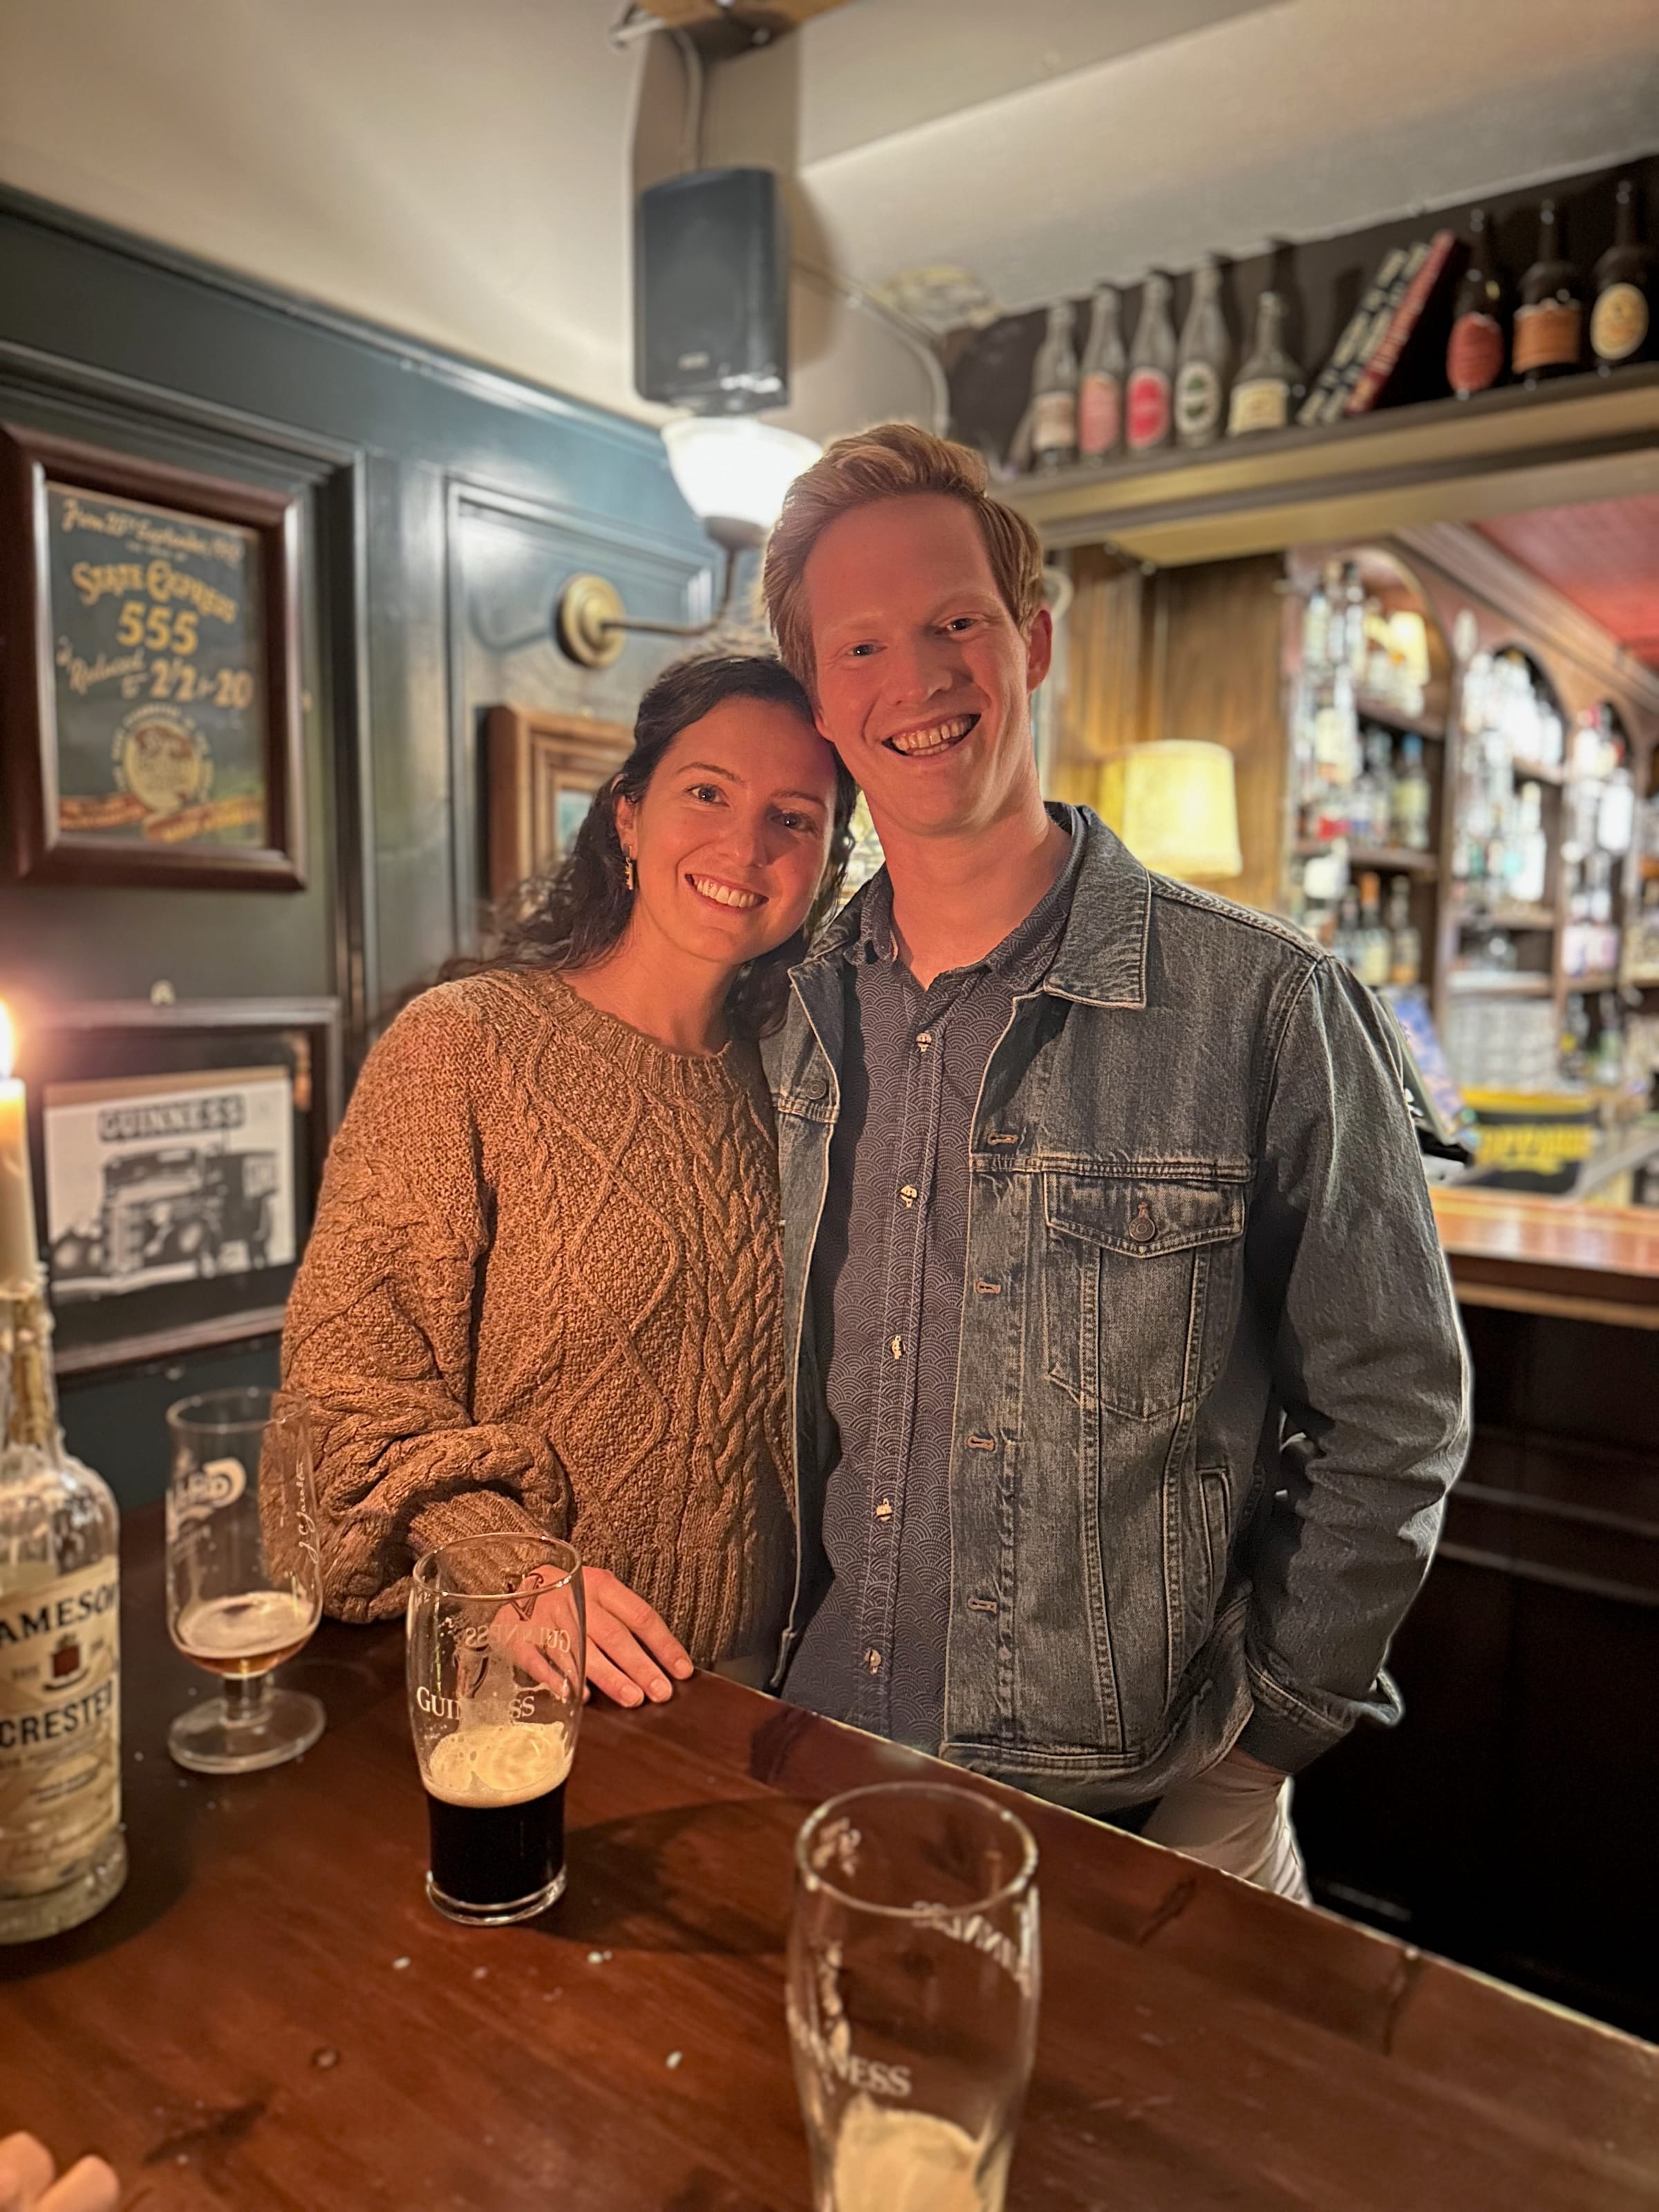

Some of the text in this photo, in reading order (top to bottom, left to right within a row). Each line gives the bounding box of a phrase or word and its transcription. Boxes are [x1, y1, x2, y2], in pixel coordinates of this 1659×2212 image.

[116, 601, 198, 655] 555
[214, 667, 254, 709] 20
[101, 1098, 242, 1141] GUINNESS
[416, 1685, 536, 1720] GUISS
